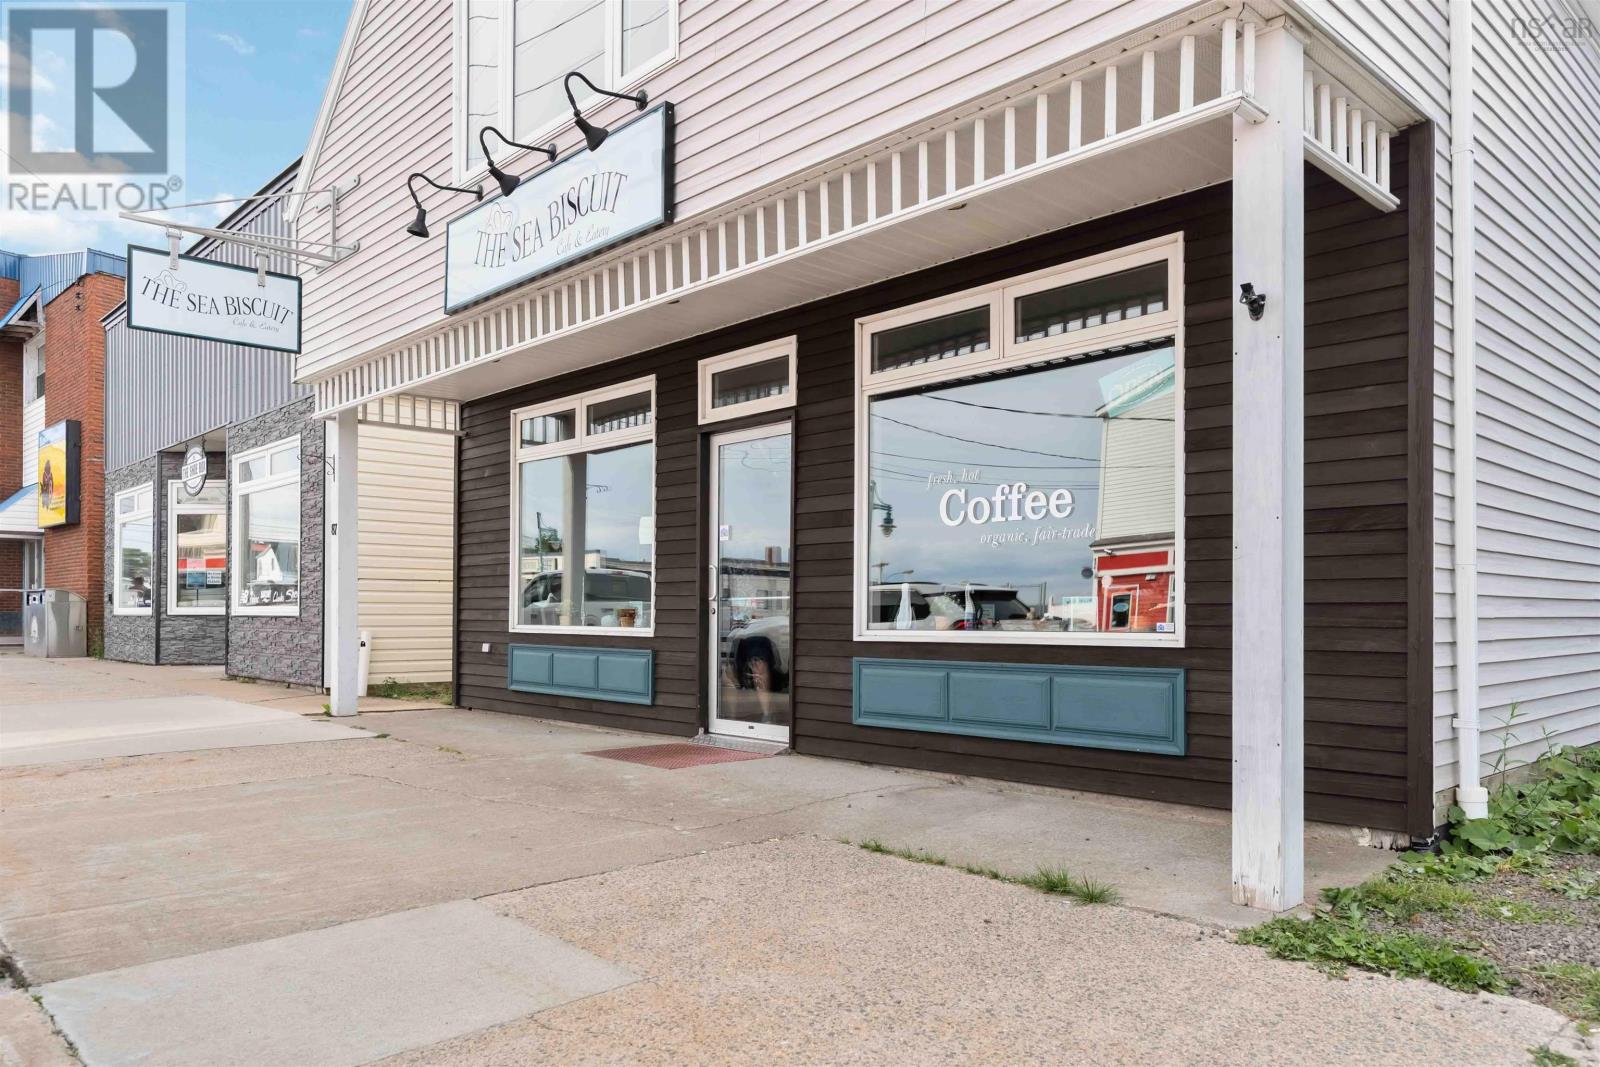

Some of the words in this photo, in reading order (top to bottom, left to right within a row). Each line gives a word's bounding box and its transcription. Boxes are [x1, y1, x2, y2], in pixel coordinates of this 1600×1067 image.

[474, 230, 508, 267] THE
[512, 217, 544, 262] SEA
[547, 171, 628, 241] BISCUIT
[141, 275, 182, 310] THE
[186, 292, 220, 315] SEA
[224, 296, 294, 325] BISCUIT
[926, 470, 957, 489] fresh,
[961, 468, 981, 481] hot
[939, 482, 1074, 527] Coffee
[980, 528, 1028, 549] organic,
[1032, 523, 1096, 546] fair-trade
